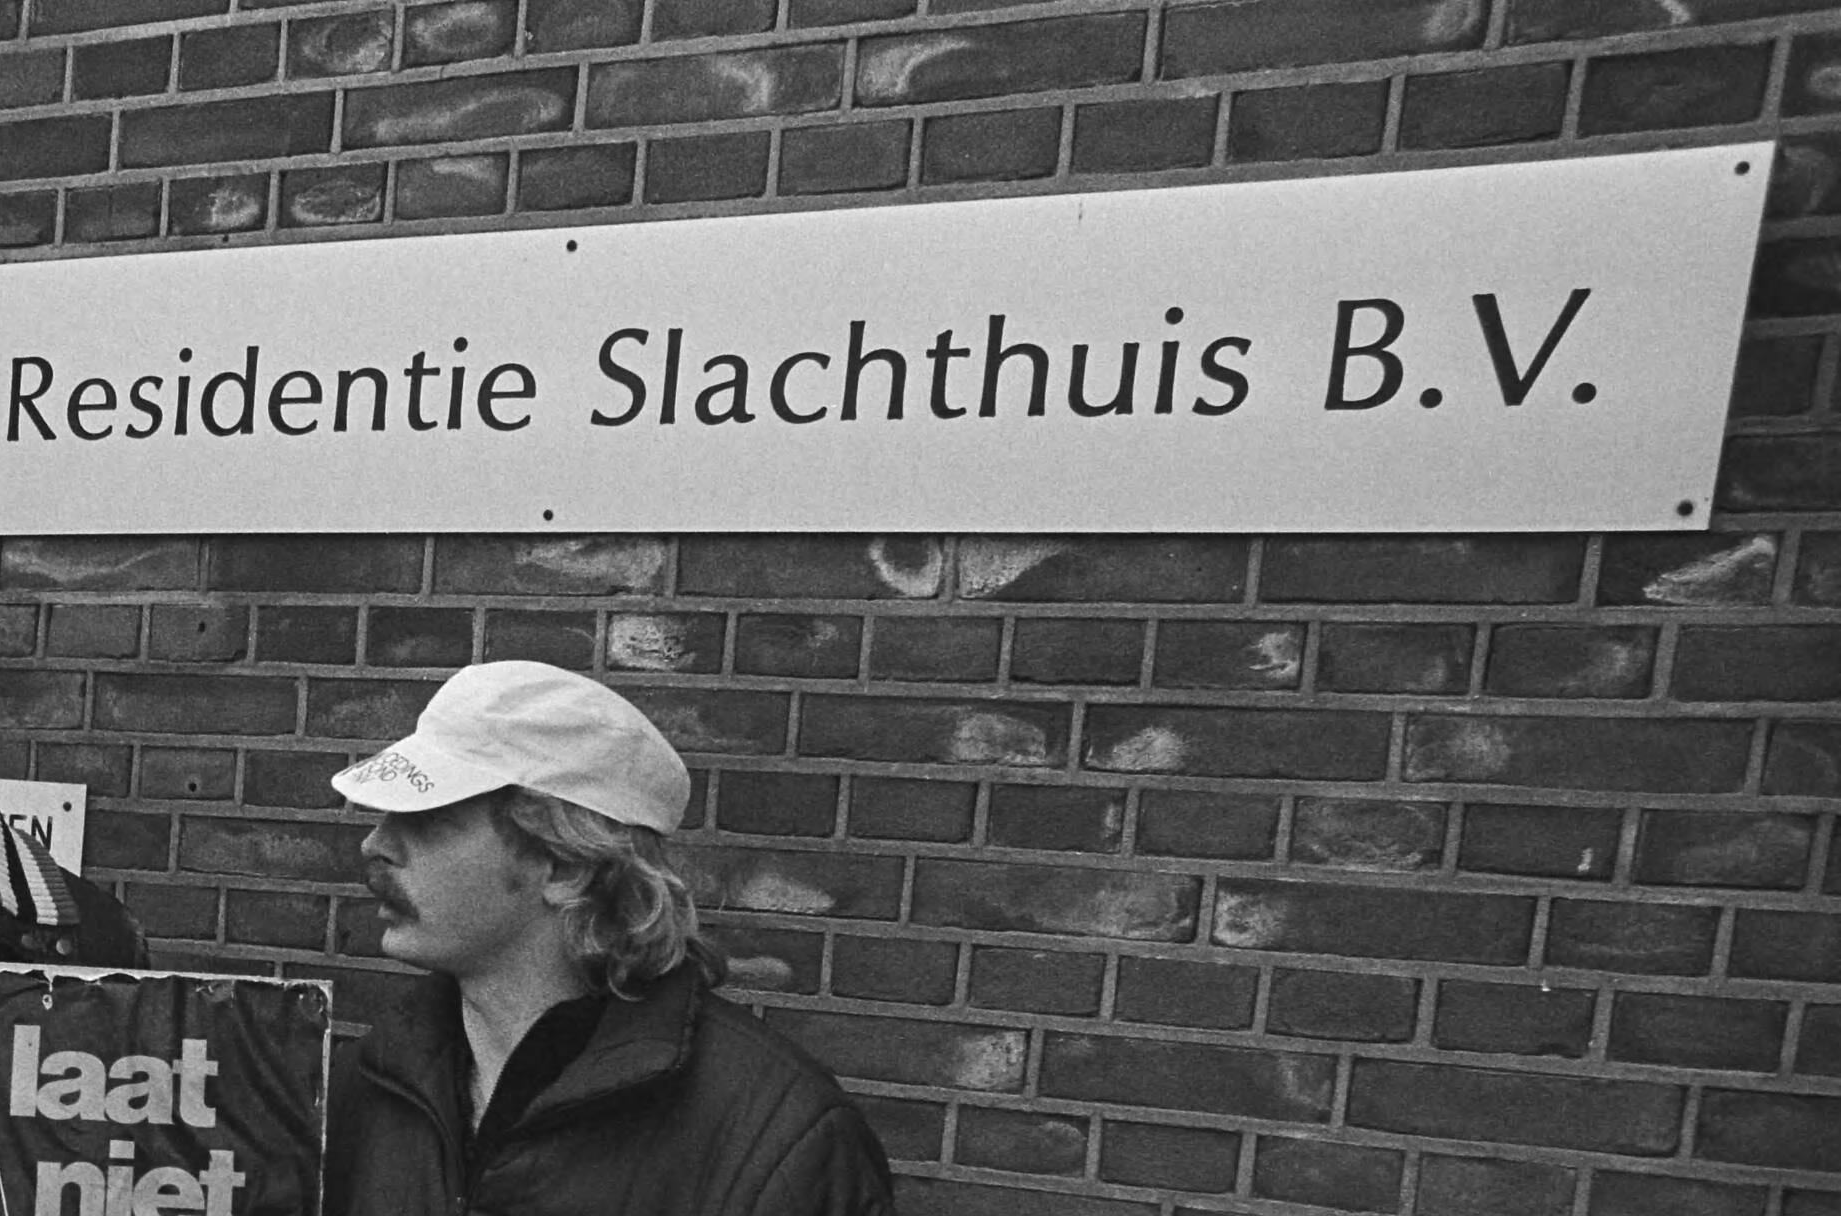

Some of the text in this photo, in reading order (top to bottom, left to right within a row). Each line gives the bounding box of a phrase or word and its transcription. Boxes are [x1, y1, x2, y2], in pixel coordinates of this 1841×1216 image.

[7, 337, 536, 441] Residentie
[591, 307, 1251, 426] Slachthuis
[1325, 288, 1597, 410] B.V.
[10, 1025, 218, 1127] laat
